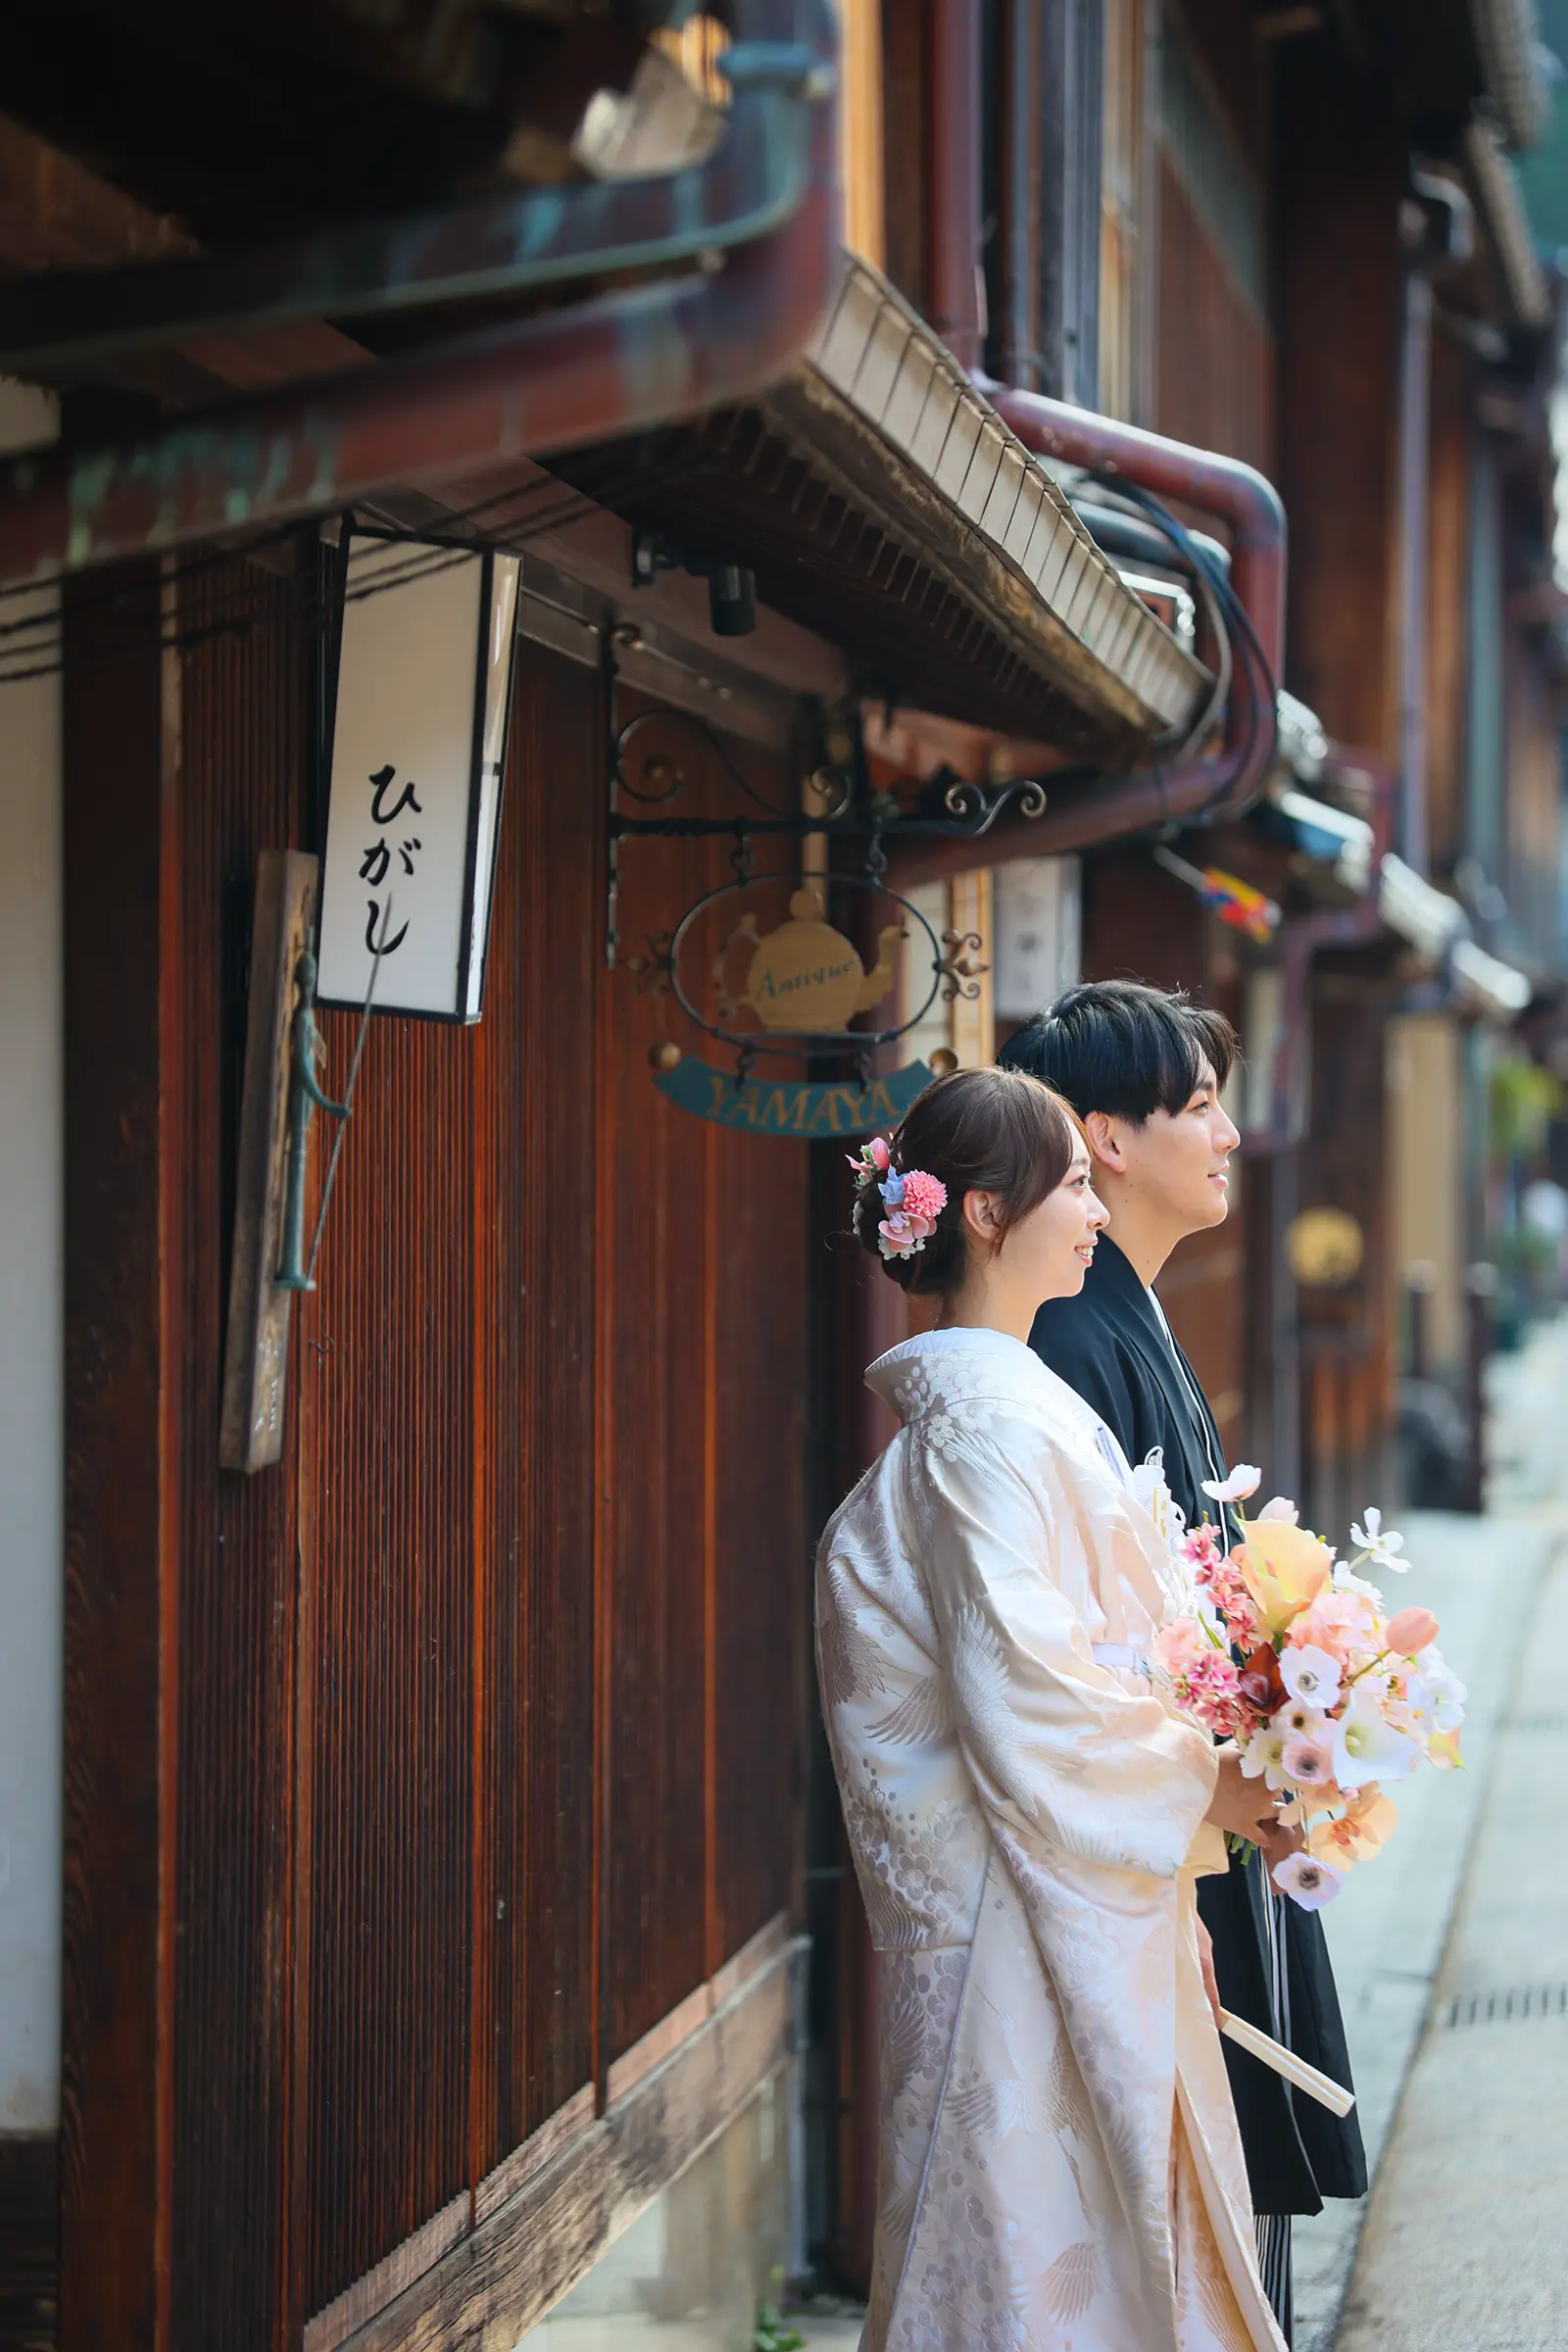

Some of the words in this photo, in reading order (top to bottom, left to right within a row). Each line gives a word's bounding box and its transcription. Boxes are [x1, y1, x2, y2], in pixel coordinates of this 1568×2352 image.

[359, 763, 422, 956] ひがし
[707, 1076, 901, 1131] YAMAYA
